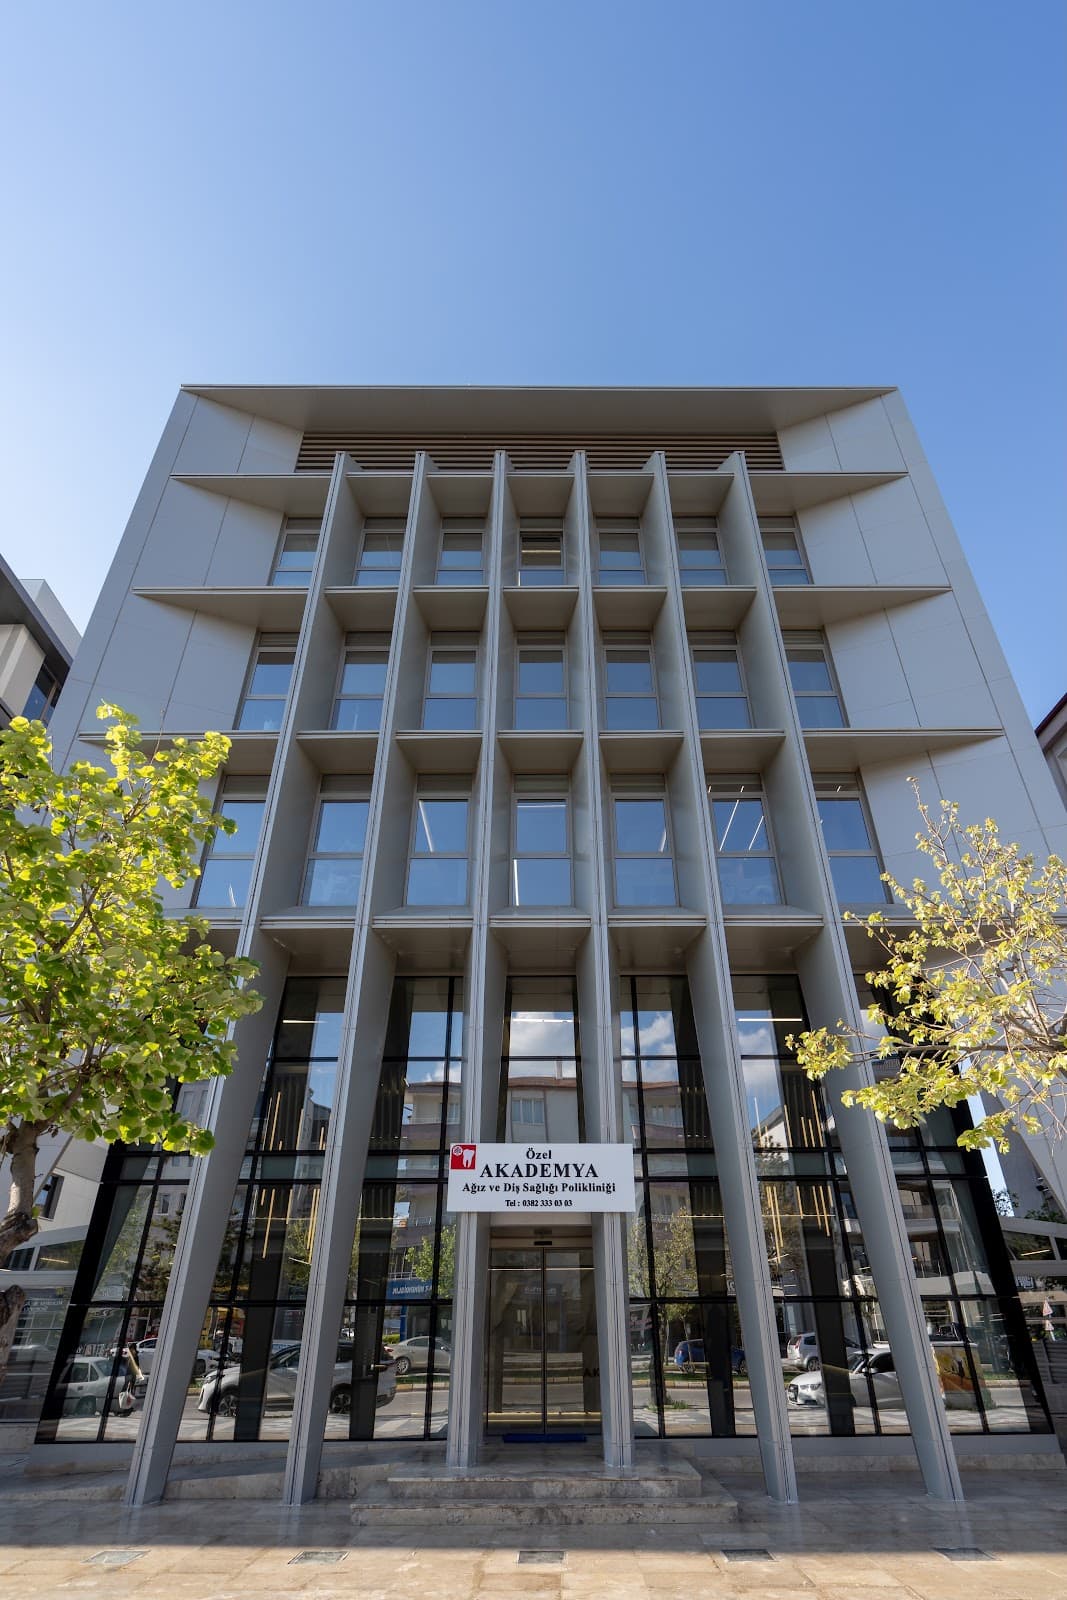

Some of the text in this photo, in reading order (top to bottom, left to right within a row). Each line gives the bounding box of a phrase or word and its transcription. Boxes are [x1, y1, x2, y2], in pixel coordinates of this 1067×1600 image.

[526, 1147, 552, 1160] Özel
[479, 1163, 599, 1178] AKADEMYA
[462, 1183, 616, 1195] Ağız ve Diş Sağlığı Polikliniği
[505, 1199, 517, 1207] Tel
[522, 1199, 539, 1207] 0382
[540, 1199, 553, 1207] 333
[554, 1199, 563, 1207] 03
[564, 1199, 573, 1207] 03
